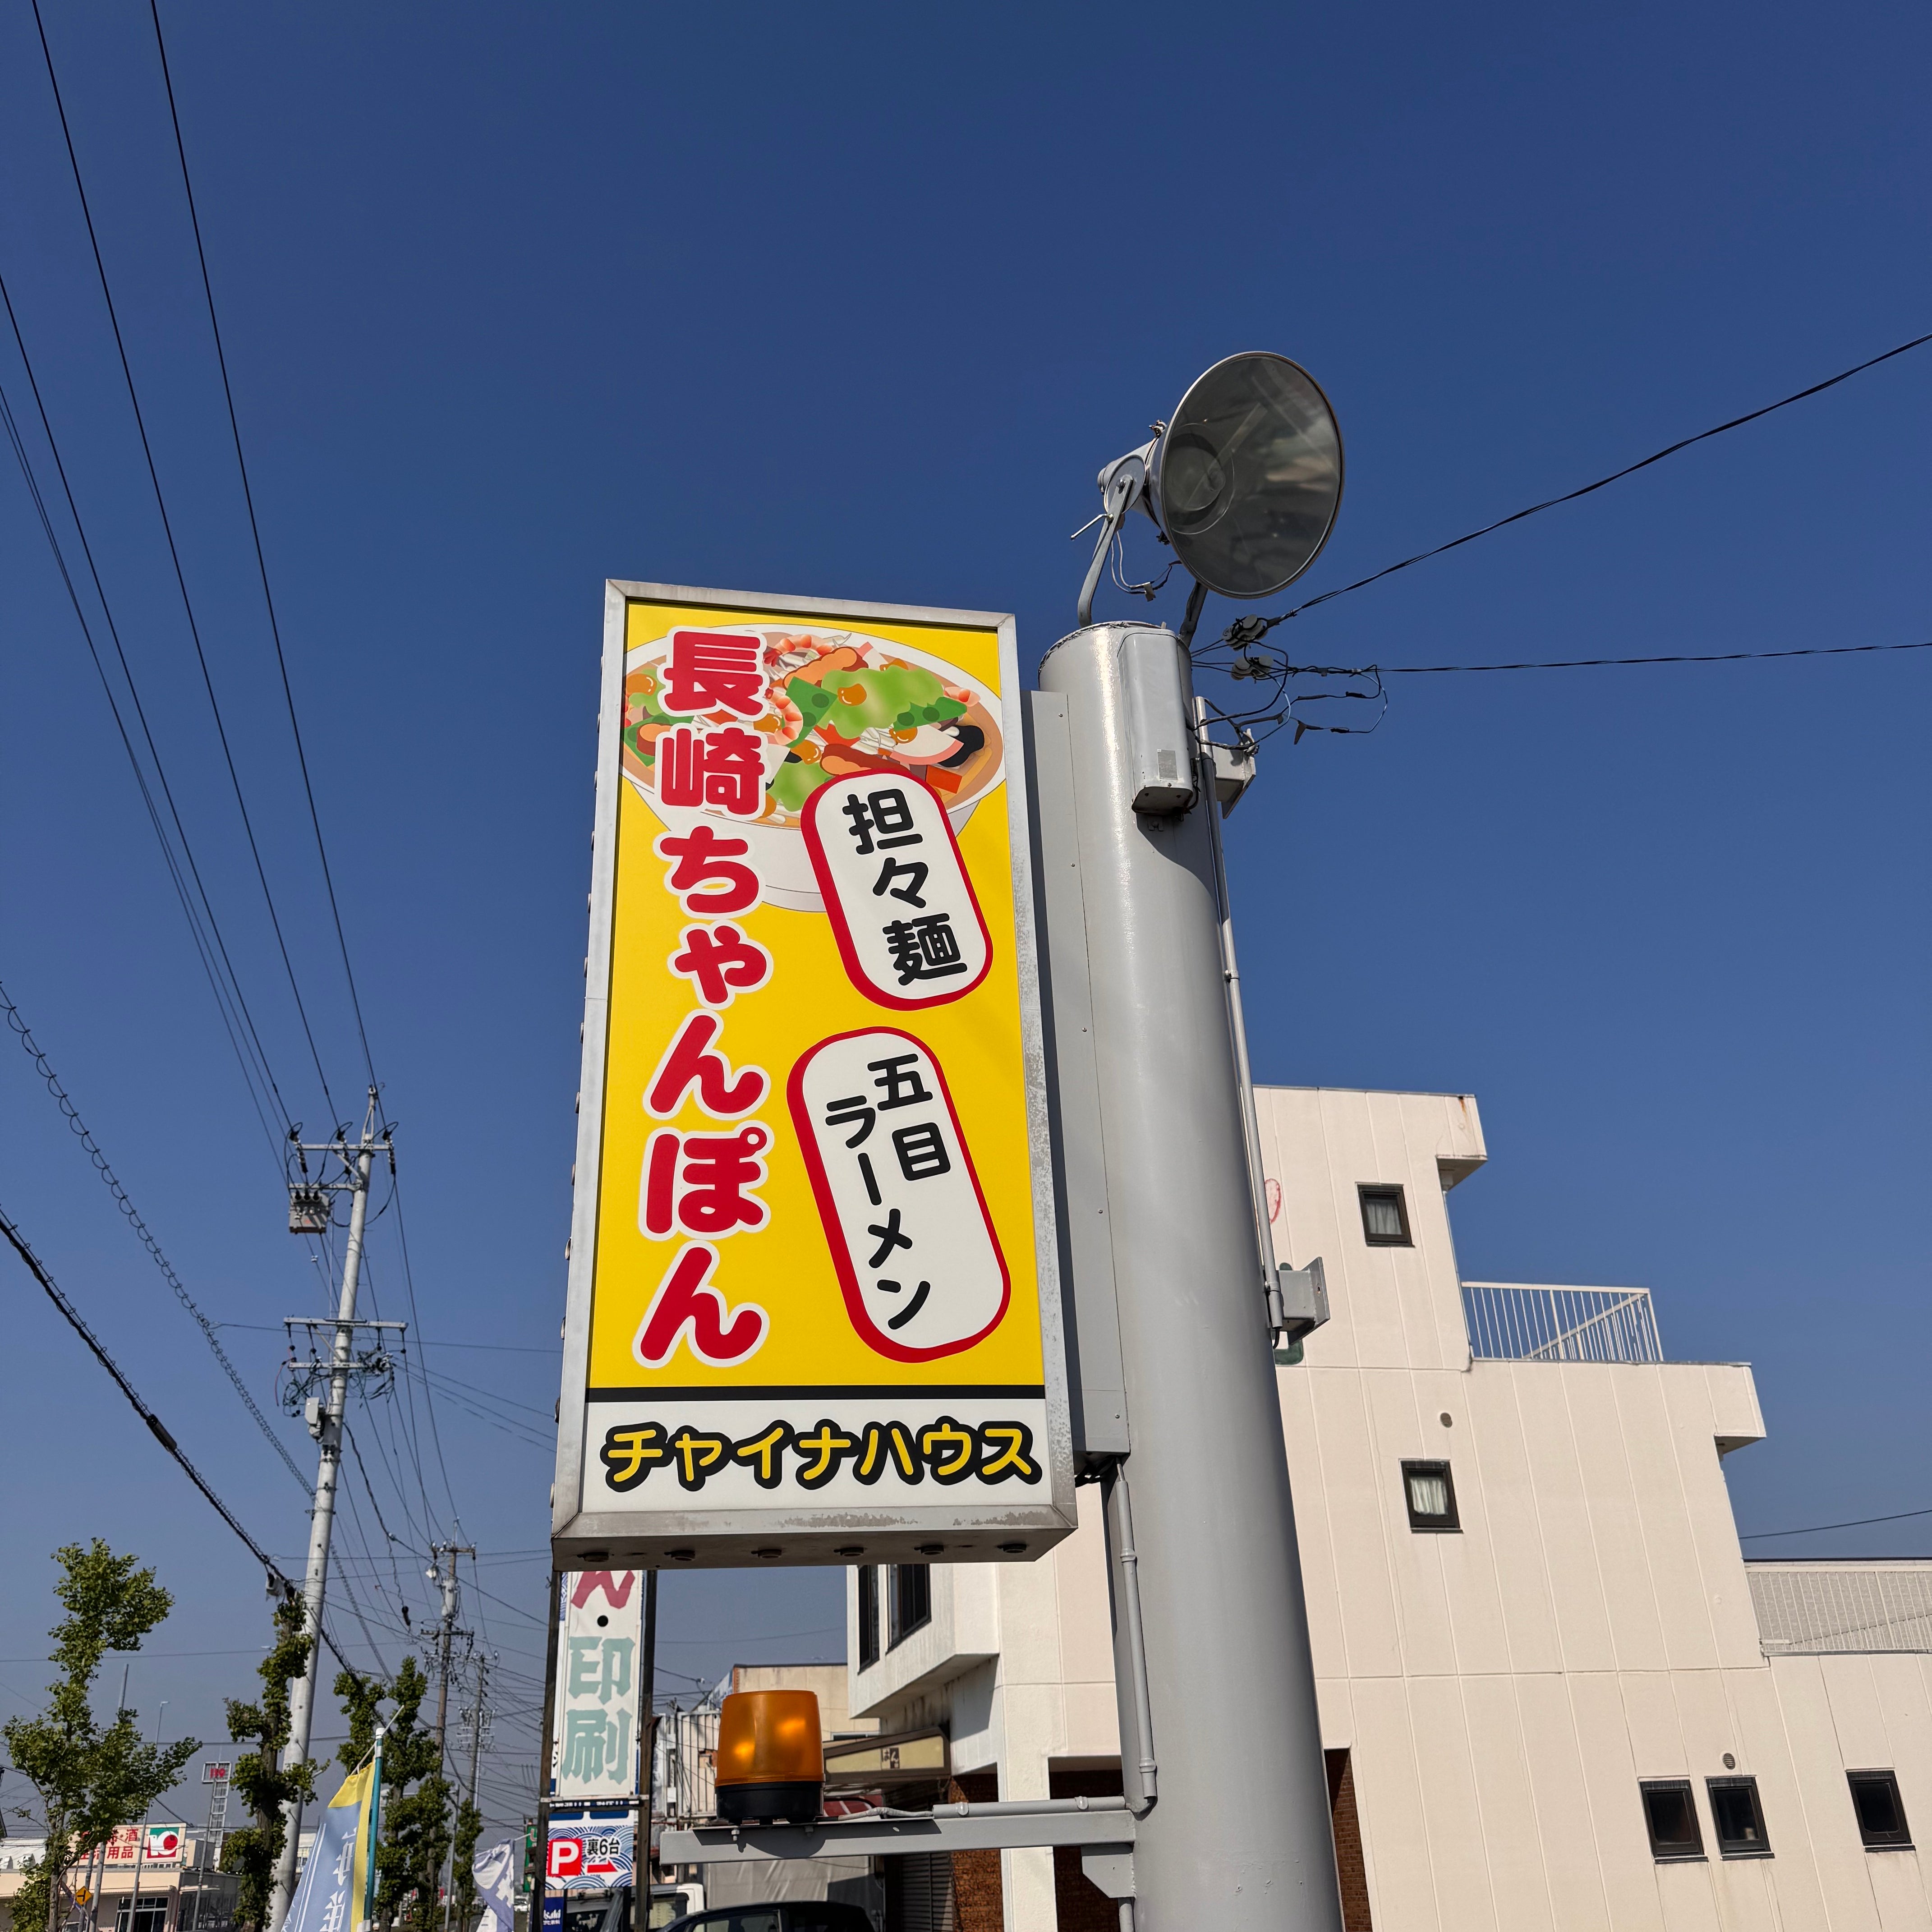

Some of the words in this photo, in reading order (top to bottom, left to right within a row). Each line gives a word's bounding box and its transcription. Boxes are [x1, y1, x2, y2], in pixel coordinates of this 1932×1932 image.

[842, 789, 967, 986] 担々麺
[641, 632, 767, 1360] 長崎ちゃんぽん
[868, 1054, 951, 1181] 五目
[826, 1095, 930, 1329] ラーメン
[603, 1419, 1039, 1489] チャイナハウス
[551, 1841, 579, 1874] P
[587, 1838, 620, 1855] 裏6台
